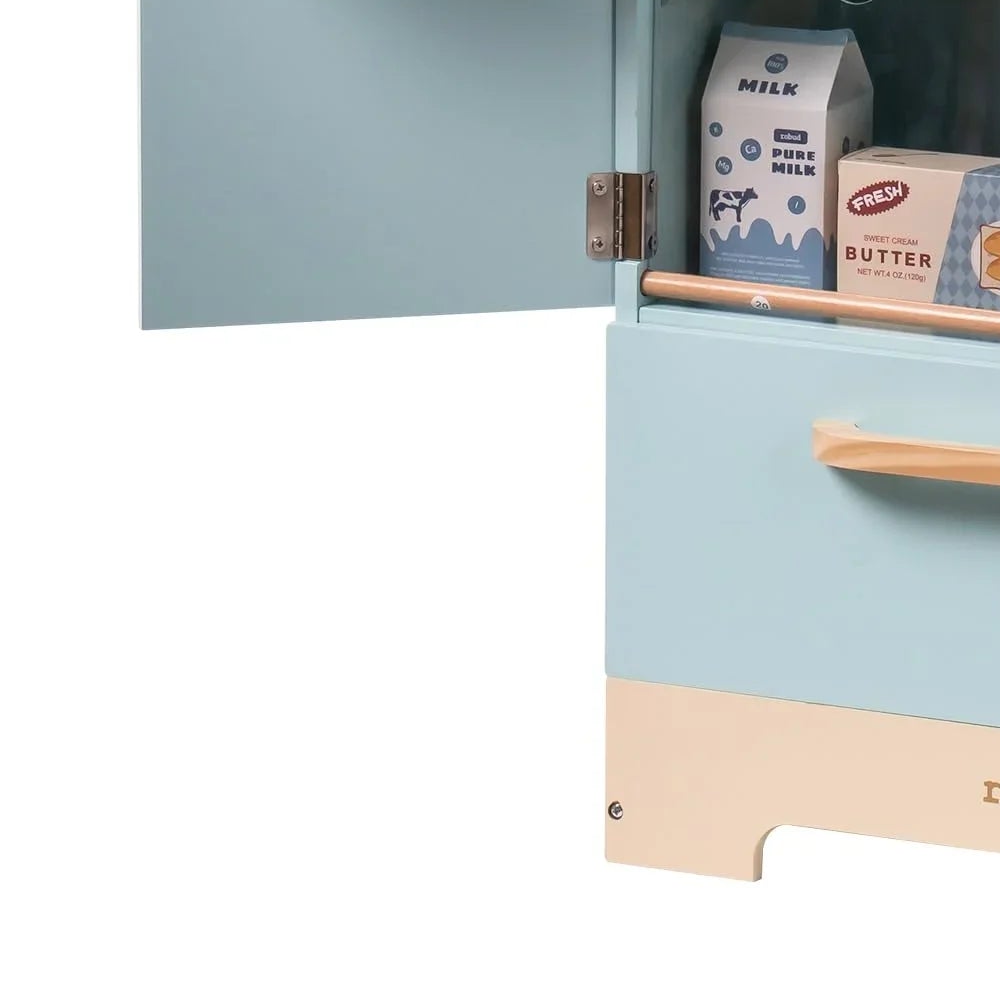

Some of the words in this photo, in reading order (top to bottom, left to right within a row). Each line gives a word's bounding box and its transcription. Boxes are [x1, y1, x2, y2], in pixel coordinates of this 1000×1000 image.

[738, 78, 799, 97] MILK
[780, 132, 801, 141] robud
[744, 144, 757, 154] Ca
[772, 148, 816, 161] PURE
[772, 162, 816, 177] MILK
[851, 180, 903, 212] FRESH
[863, 234, 890, 245] SWEET
[891, 236, 919, 247] CREAM
[845, 246, 932, 269] BUTTER
[857, 267, 872, 277] NET
